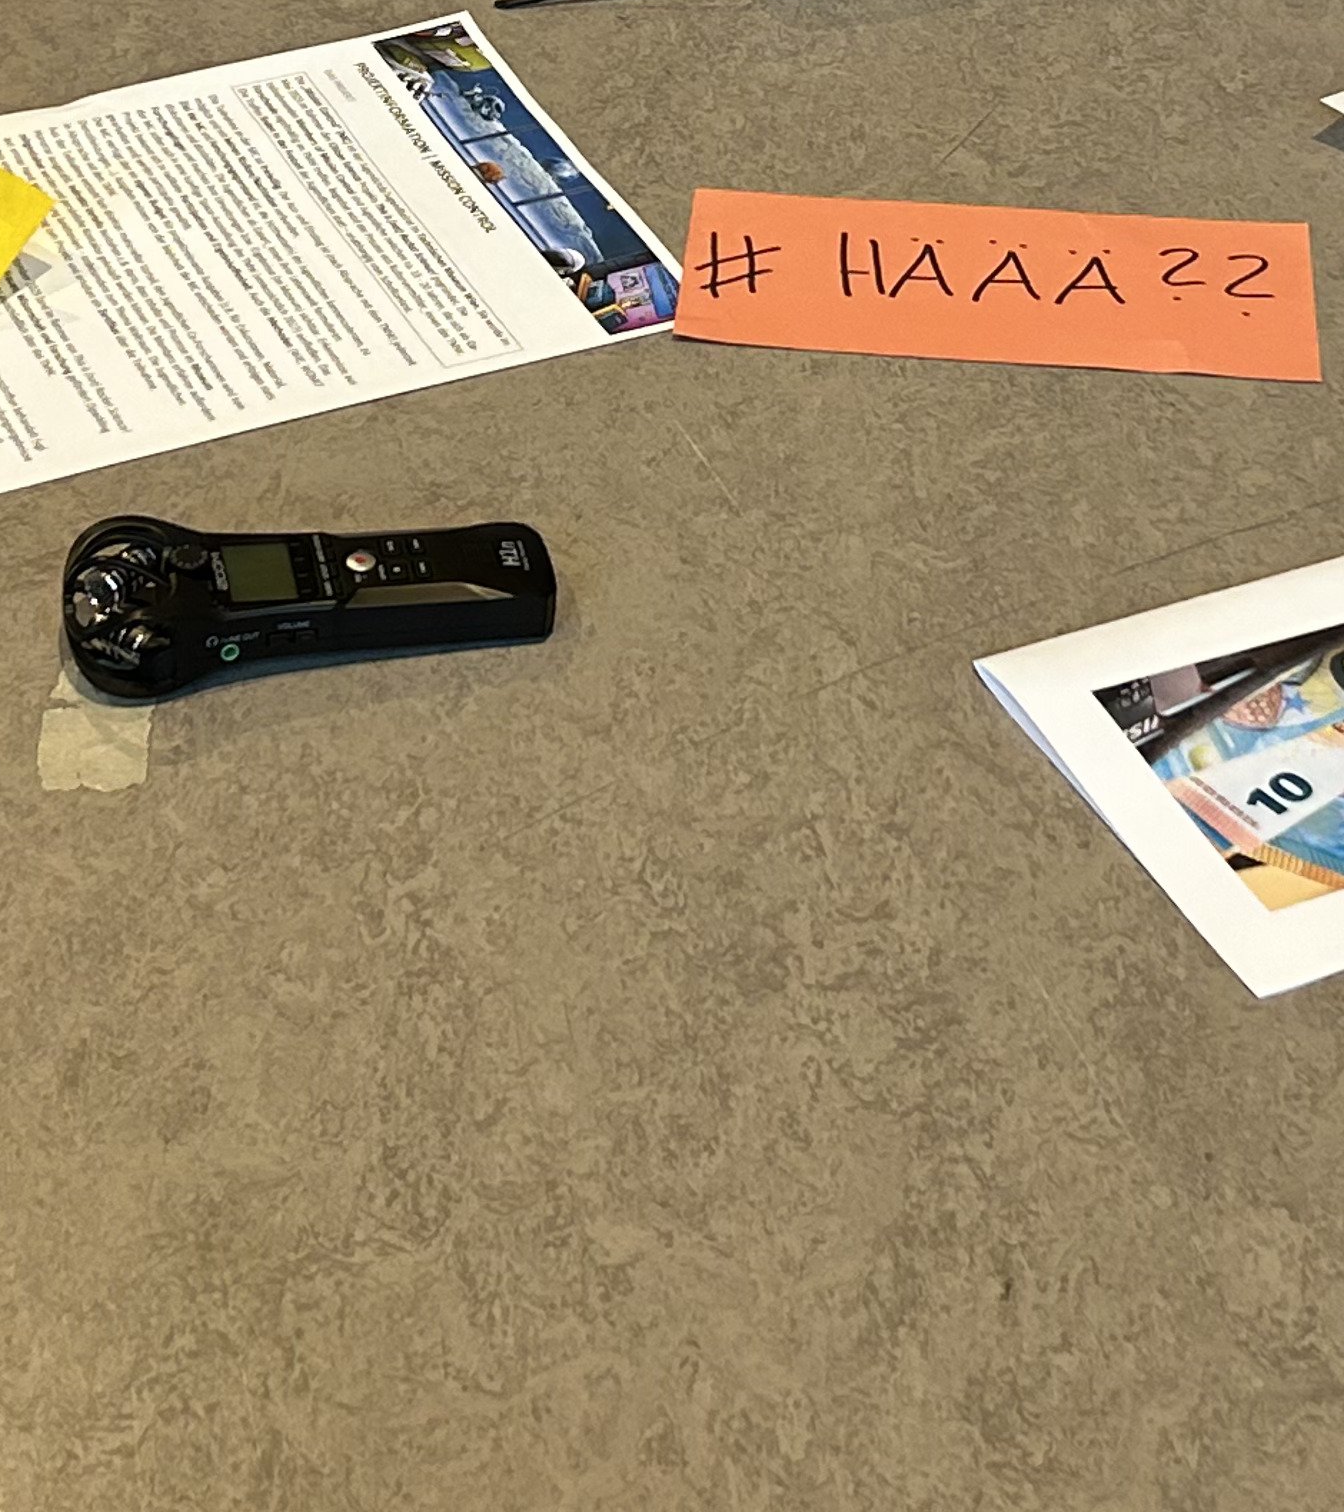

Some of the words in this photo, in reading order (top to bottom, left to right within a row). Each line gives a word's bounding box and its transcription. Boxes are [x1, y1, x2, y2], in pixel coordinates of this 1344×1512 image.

[352, 61, 432, 153] PROJEKTINFORMATION
[428, 160, 466, 194] MISSION
[456, 194, 498, 233] CONTROL
[694, 230, 782, 300] #
[498, 540, 522, 567] H1n
[1244, 769, 1315, 817] 10
